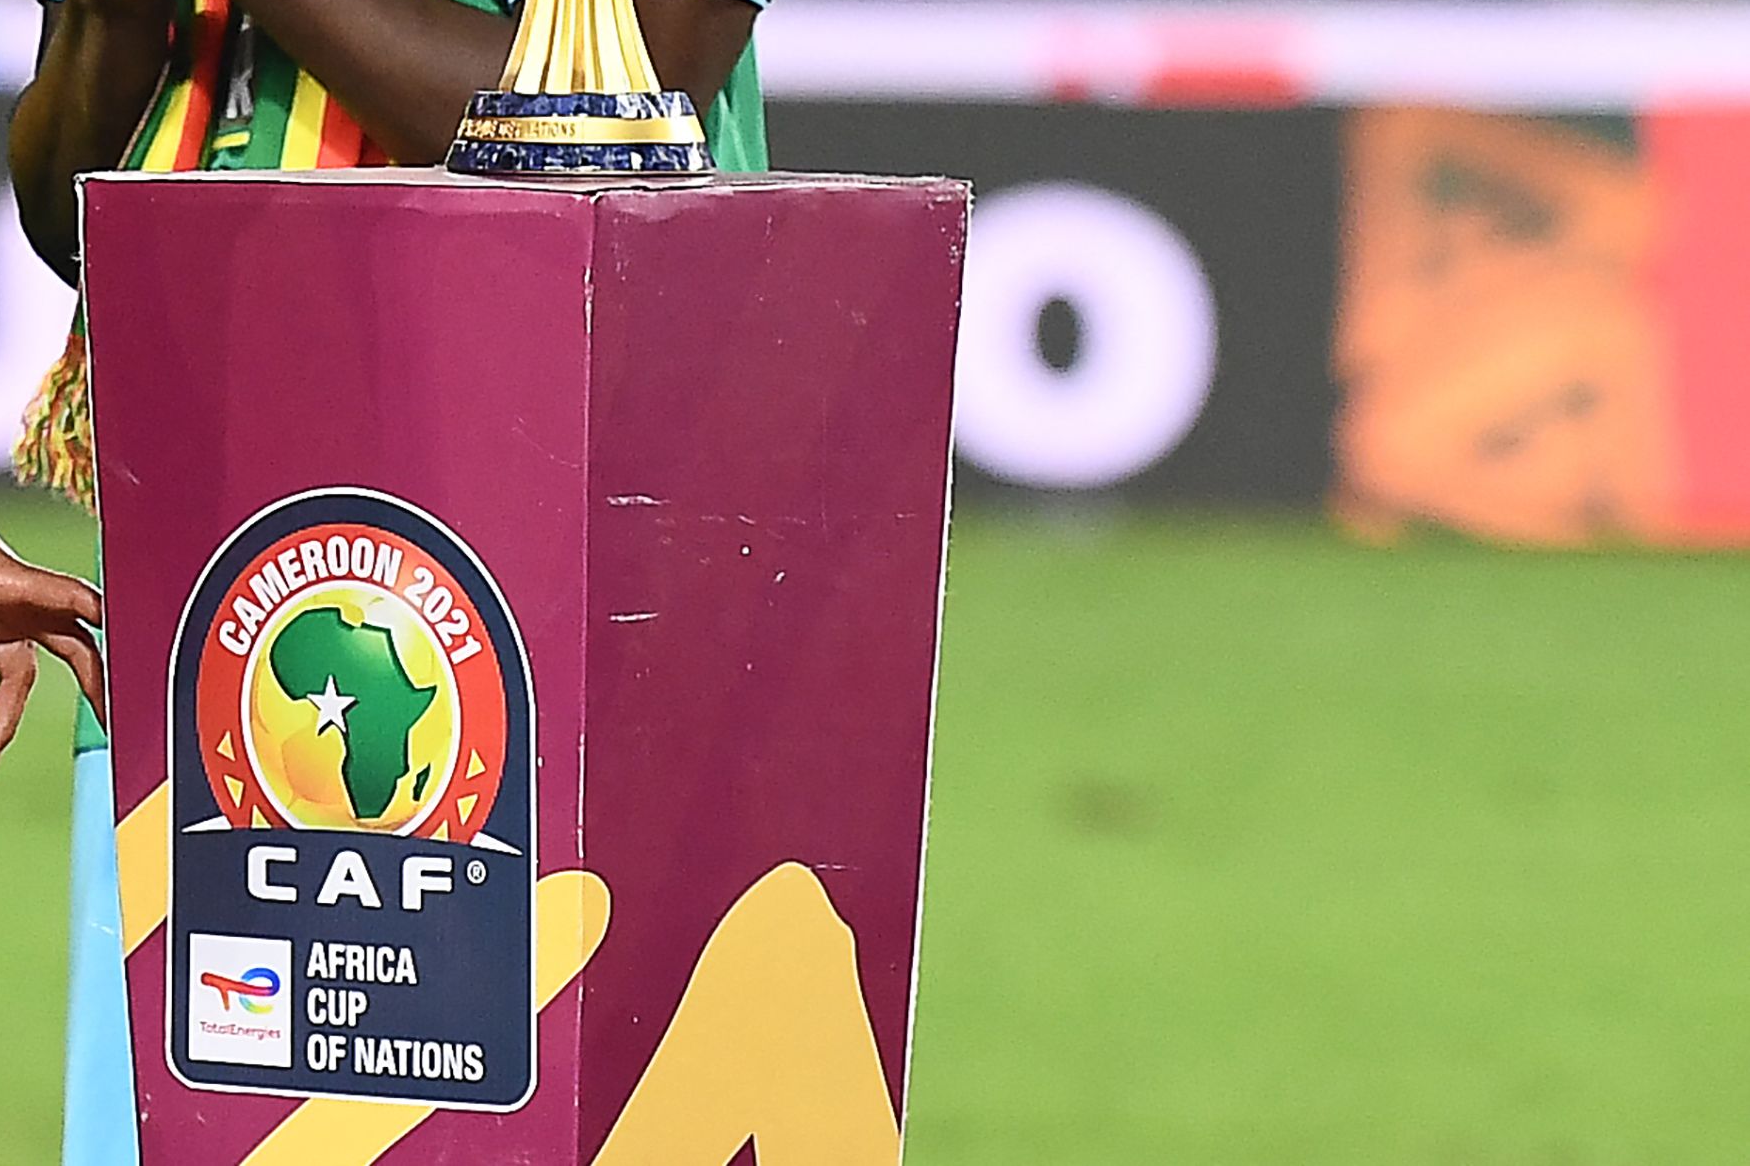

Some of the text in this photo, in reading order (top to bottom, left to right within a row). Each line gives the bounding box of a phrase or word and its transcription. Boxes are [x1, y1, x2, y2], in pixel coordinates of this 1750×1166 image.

[218, 536, 482, 665] CAMEROON 2021
[306, 941, 418, 985] AFRICA
[306, 987, 368, 1027] CUP
[200, 1021, 281, 1040] TotalEnergies
[306, 1033, 485, 1082] OF NATIONS
